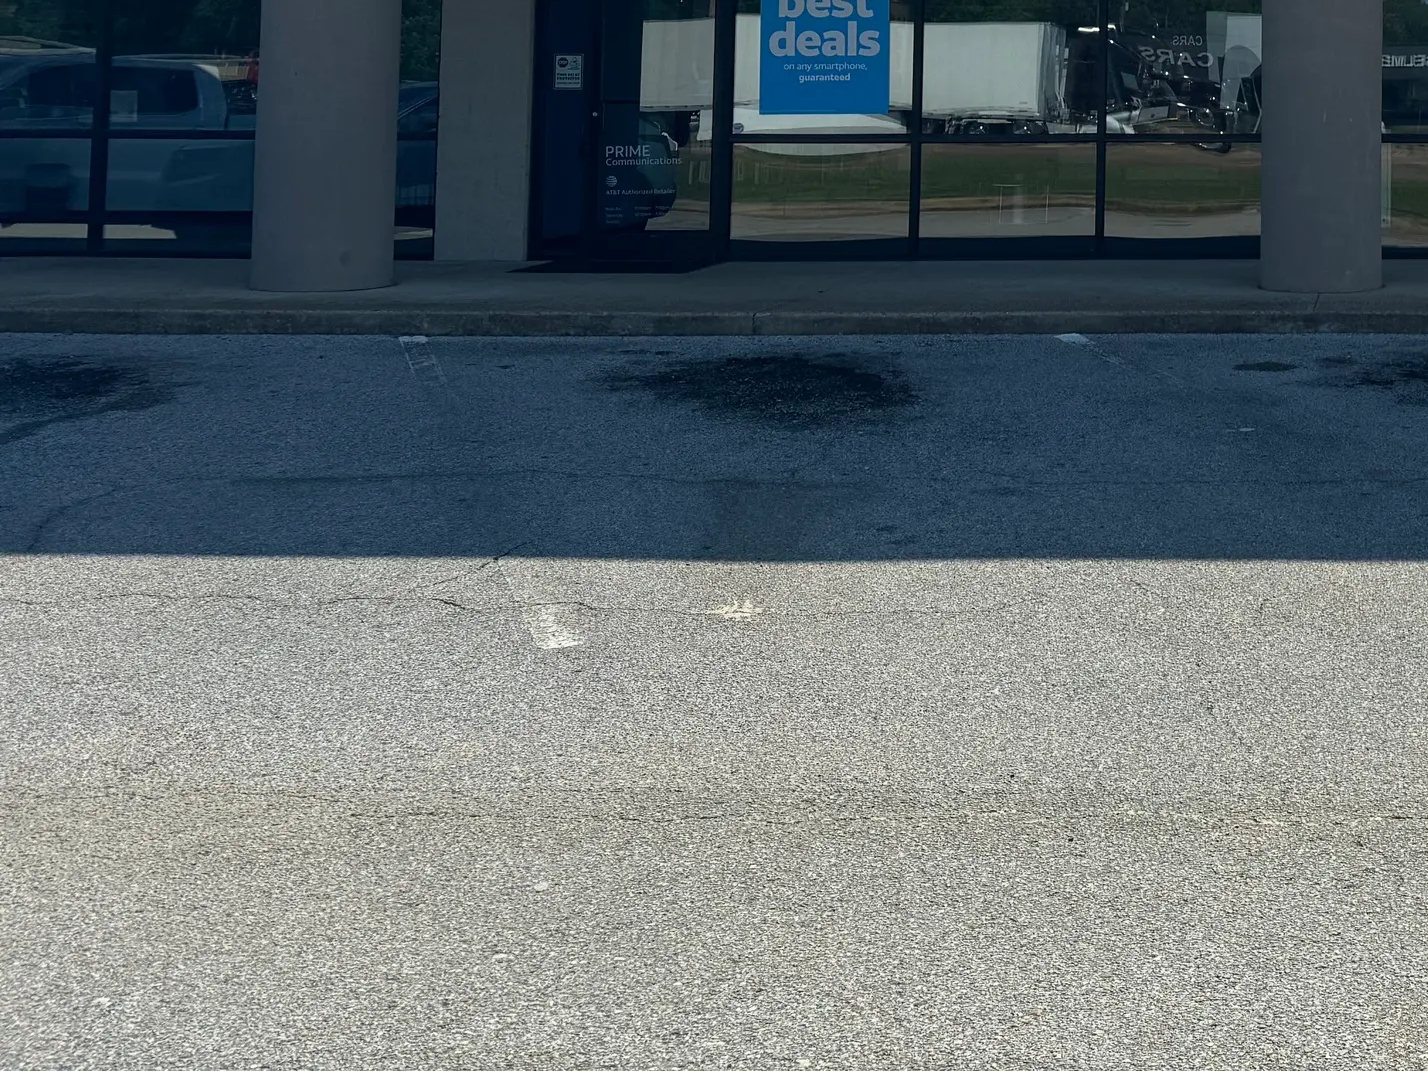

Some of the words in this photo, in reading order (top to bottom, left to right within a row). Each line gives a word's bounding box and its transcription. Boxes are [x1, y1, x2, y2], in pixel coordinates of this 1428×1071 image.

[768, 20, 881, 58] deals
[796, 64, 813, 72] any
[798, 72, 851, 83] guaranteed
[605, 144, 651, 158] PRIME
[605, 156, 683, 167] Communications
